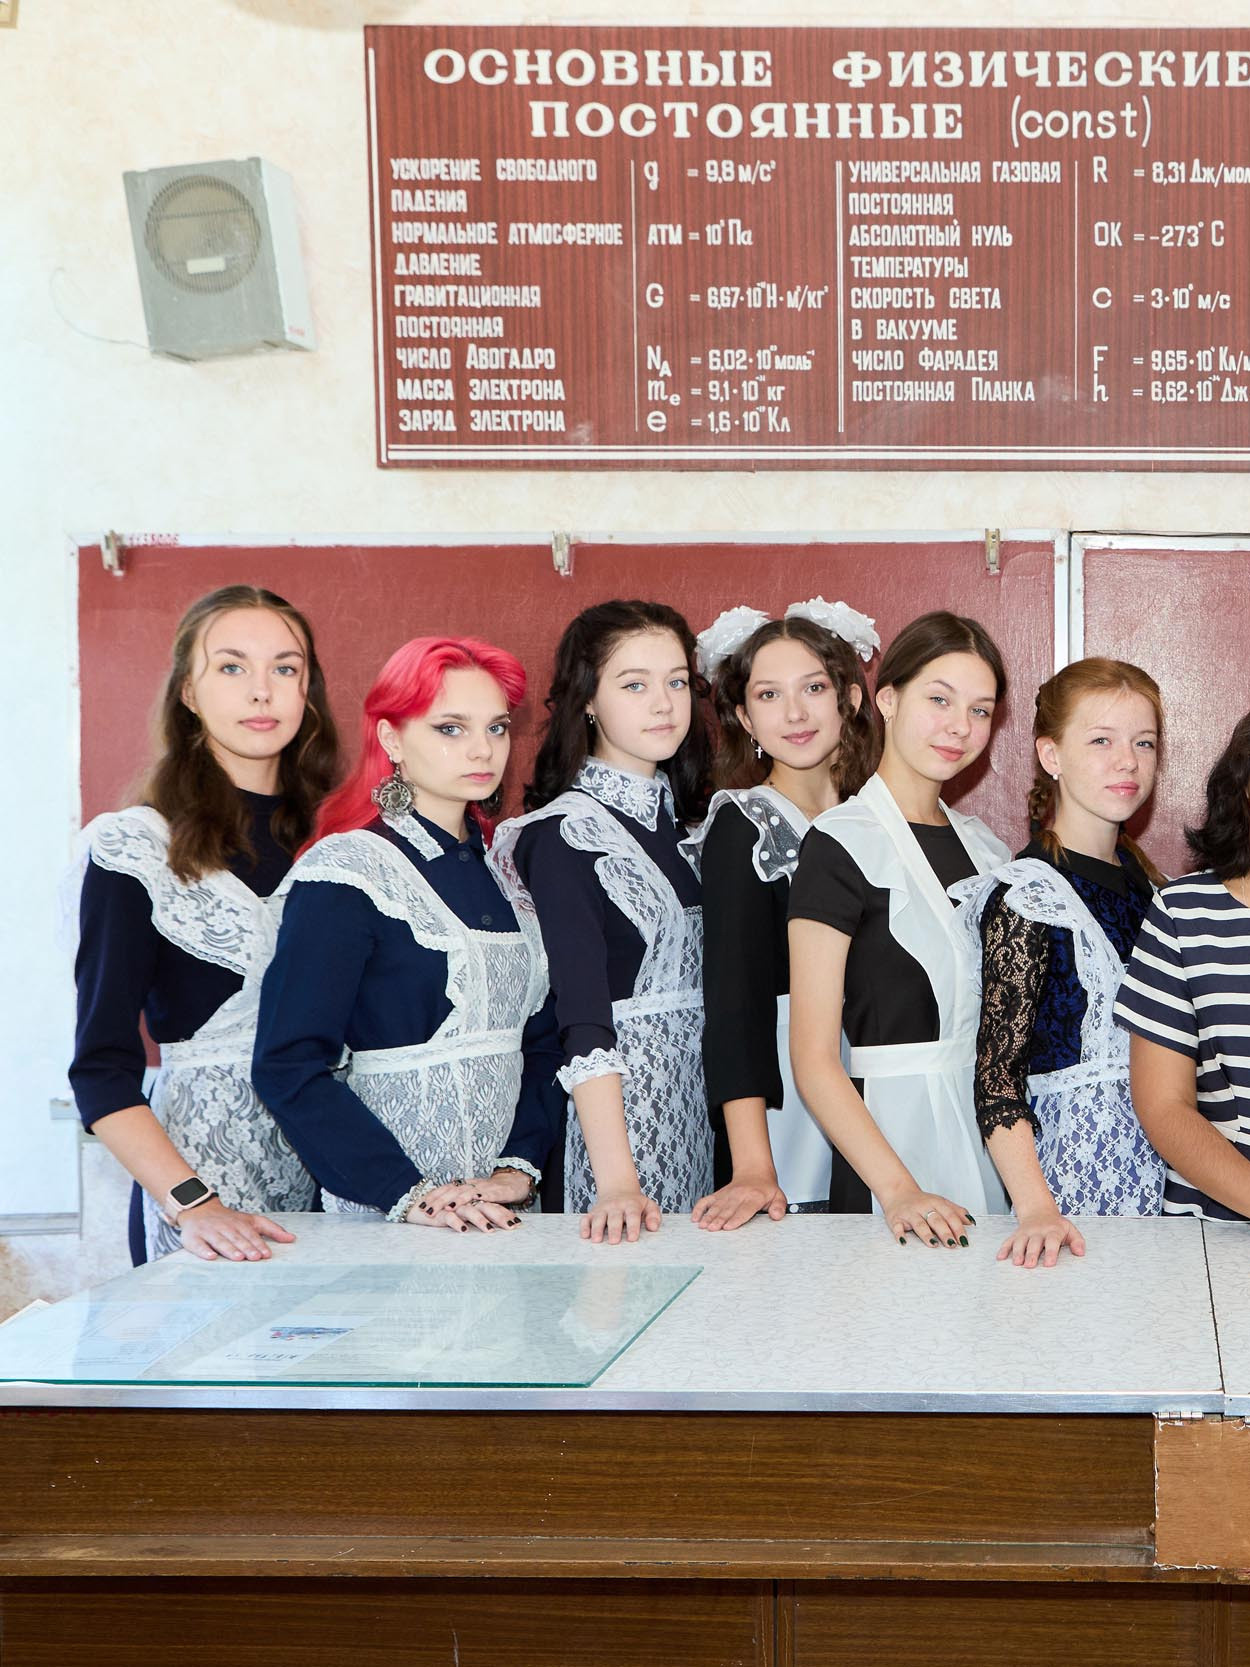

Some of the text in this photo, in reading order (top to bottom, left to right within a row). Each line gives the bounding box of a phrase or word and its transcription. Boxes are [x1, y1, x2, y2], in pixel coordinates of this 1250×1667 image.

[423, 48, 772, 87] ОСНОВНЫЕ
[528, 95, 1152, 148] ПОСТОЯННЫЕ (const)
[389, 157, 598, 182] УСКОРЕНИЕ СВОБОДНОГО
[848, 160, 1061, 184] УНИВЕРСАЛЬНАЯ ГАЗОВАЯ
[1092, 155, 1108, 183] R
[390, 189, 468, 213] ПАДЕНИЯ
[848, 192, 954, 216] ПОСТОЯННАЯ
[391, 221, 624, 246] НОРМАЛЬНОЕ АТМОСФЕРНОЕ
[647, 223, 683, 246] АТМ
[848, 218, 1013, 247] АБСОЛЮТНЫЙ НУЛЬ
[394, 252, 482, 276] ДАВЛЕНИЕ
[850, 255, 969, 279] ТЕМПЕРАТУРЫ
[394, 284, 541, 309] ГРАВИТАЦИОННАЯ
[645, 282, 664, 309] G
[850, 287, 1002, 310] СКОРОСТЬ СВЕТА
[395, 315, 504, 339] ПОСТОЯННАЯ
[851, 318, 958, 341] В ВАКУУМЕ
[395, 347, 452, 370] ЧИСЛО
[851, 346, 999, 372] ЧИСЛО ФАРАДЕЯ
[1093, 345, 1109, 372] F
[396, 378, 566, 401] МАССА ЭЛЕКТРОНА
[852, 380, 955, 402] ПОСТОЯННАЯ
[1093, 373, 1109, 403] h
[398, 409, 566, 432] ЗАРЯД ЭЛЕКТРОНА
